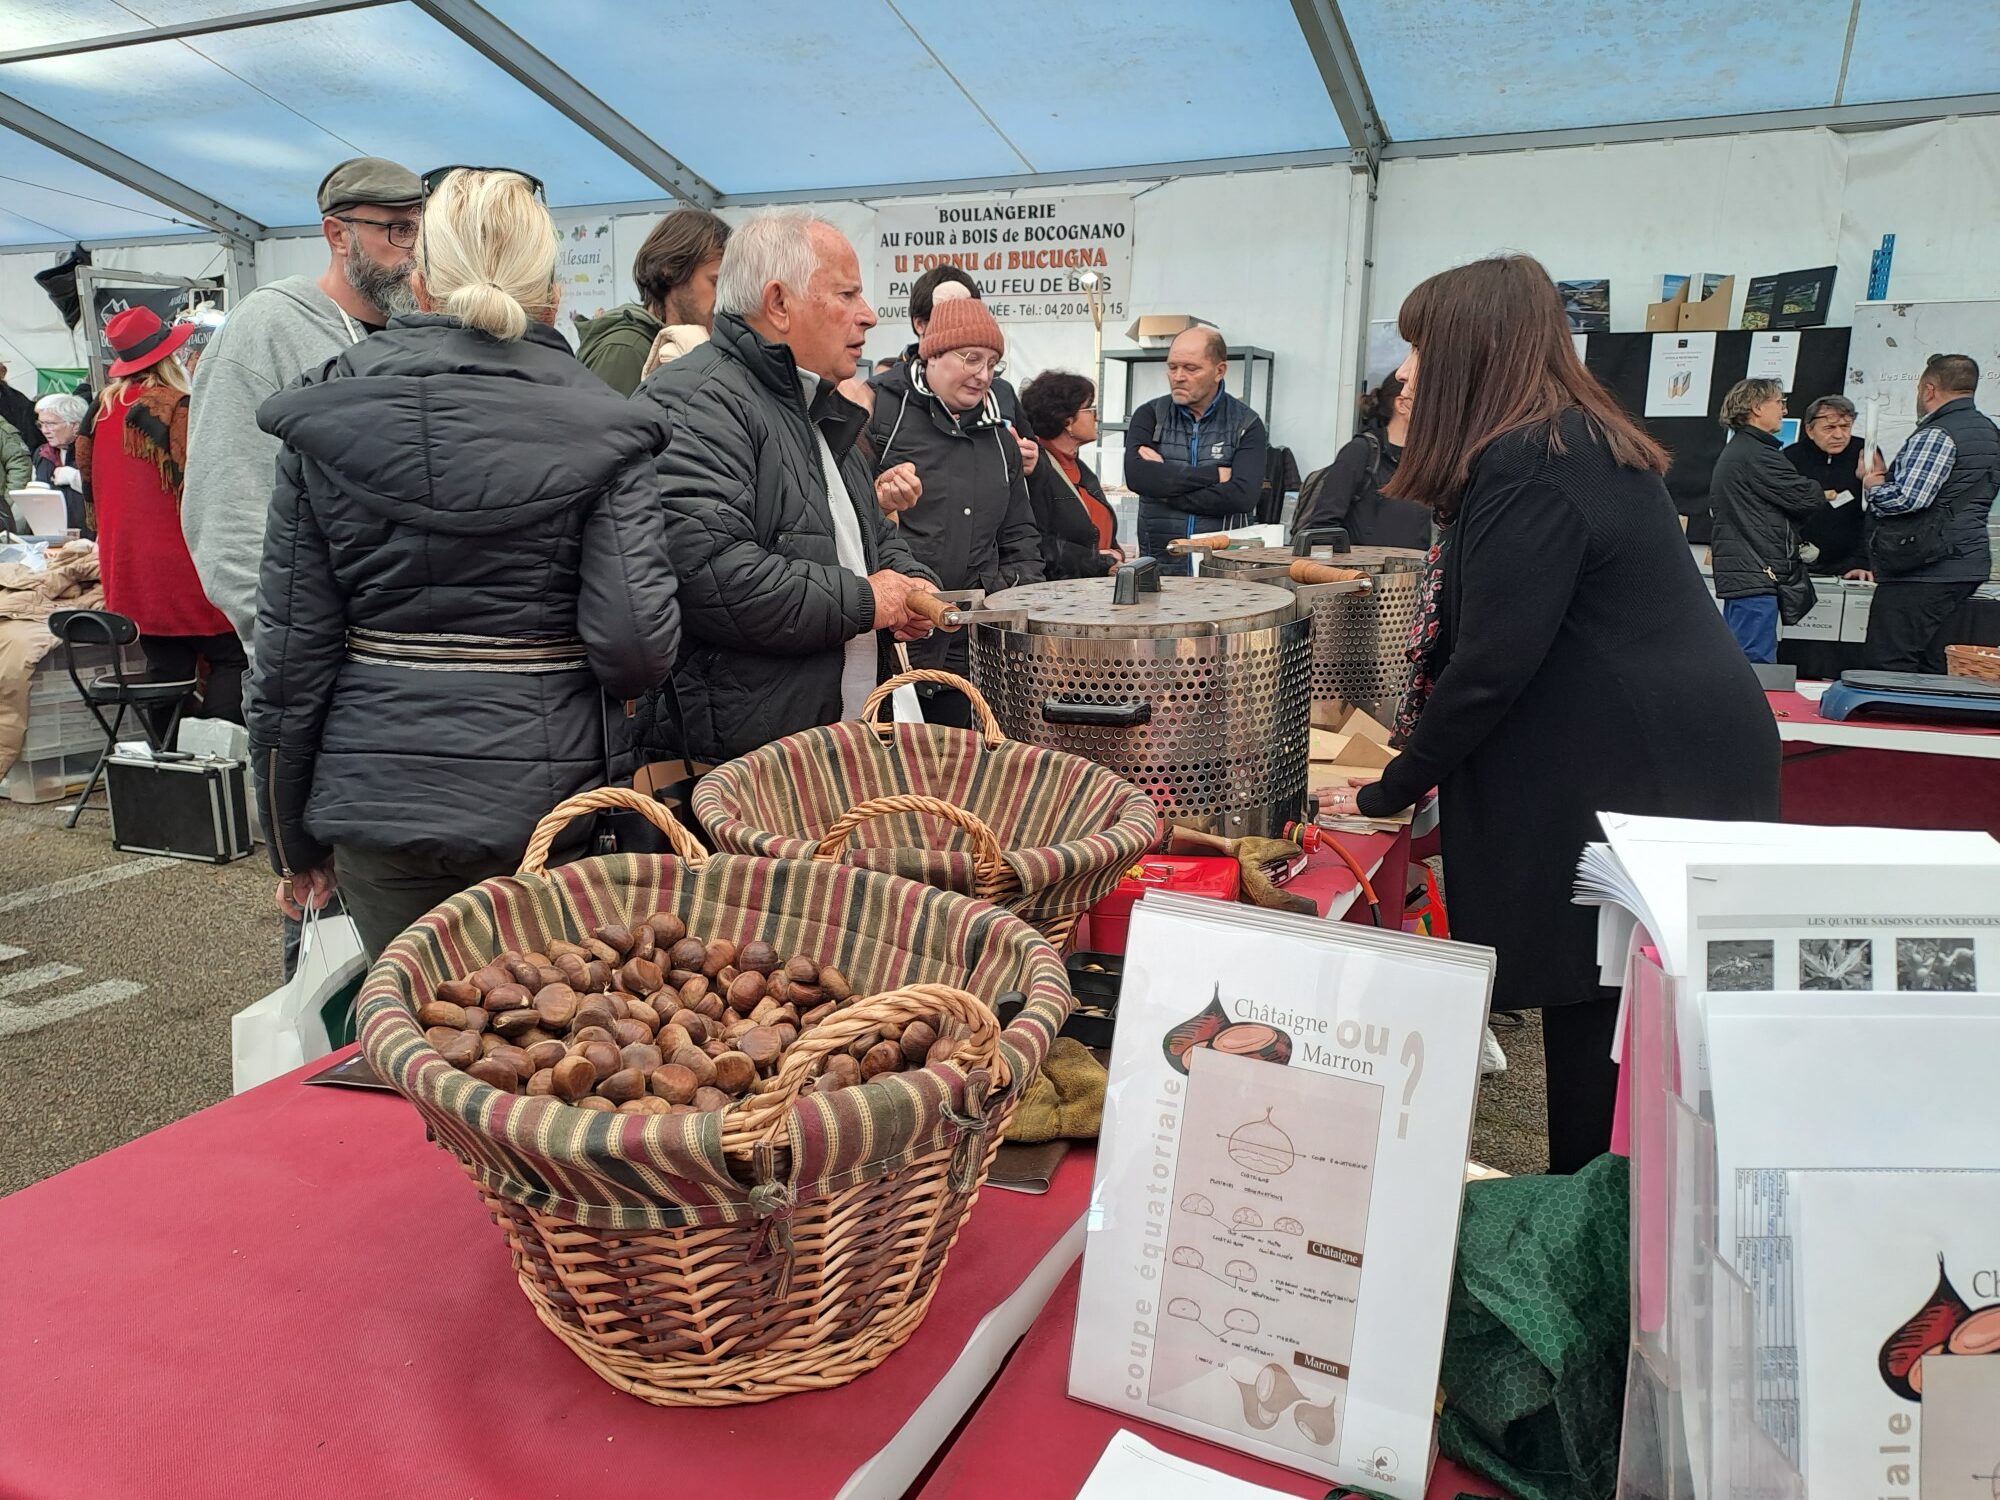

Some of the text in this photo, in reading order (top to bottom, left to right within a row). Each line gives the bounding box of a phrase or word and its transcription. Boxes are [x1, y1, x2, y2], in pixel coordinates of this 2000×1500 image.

[939, 203, 1056, 224] BOULANGERIE
[880, 222, 1125, 248] AU FOUR à BOIS de BOCOGNANO
[894, 254, 908, 273] U
[984, 251, 1002, 271] di
[1008, 247, 1108, 270] BUCUGNA
[1001, 278, 1035, 294] FEU
[1040, 277, 1062, 293] DE
[878, 305, 911, 319] OUVE
[1045, 303, 1058, 316] 04
[1060, 303, 1074, 316] 20
[1076, 303, 1090, 316] 04
[1110, 302, 1122, 315] 15
[1808, 917, 1826, 926] LES
[1828, 917, 1868, 927] QUATRE
[1234, 998, 1390, 1056] Châtaigne ou
[1302, 1042, 1374, 1076] Marron
[1397, 1030, 1425, 1140] ?
[1125, 1078, 1181, 1401] coupe équatoriale
[1312, 1241, 1359, 1265] Châtaigne
[1303, 1355, 1340, 1375] Marron
[1374, 1471, 1397, 1483] AOP
